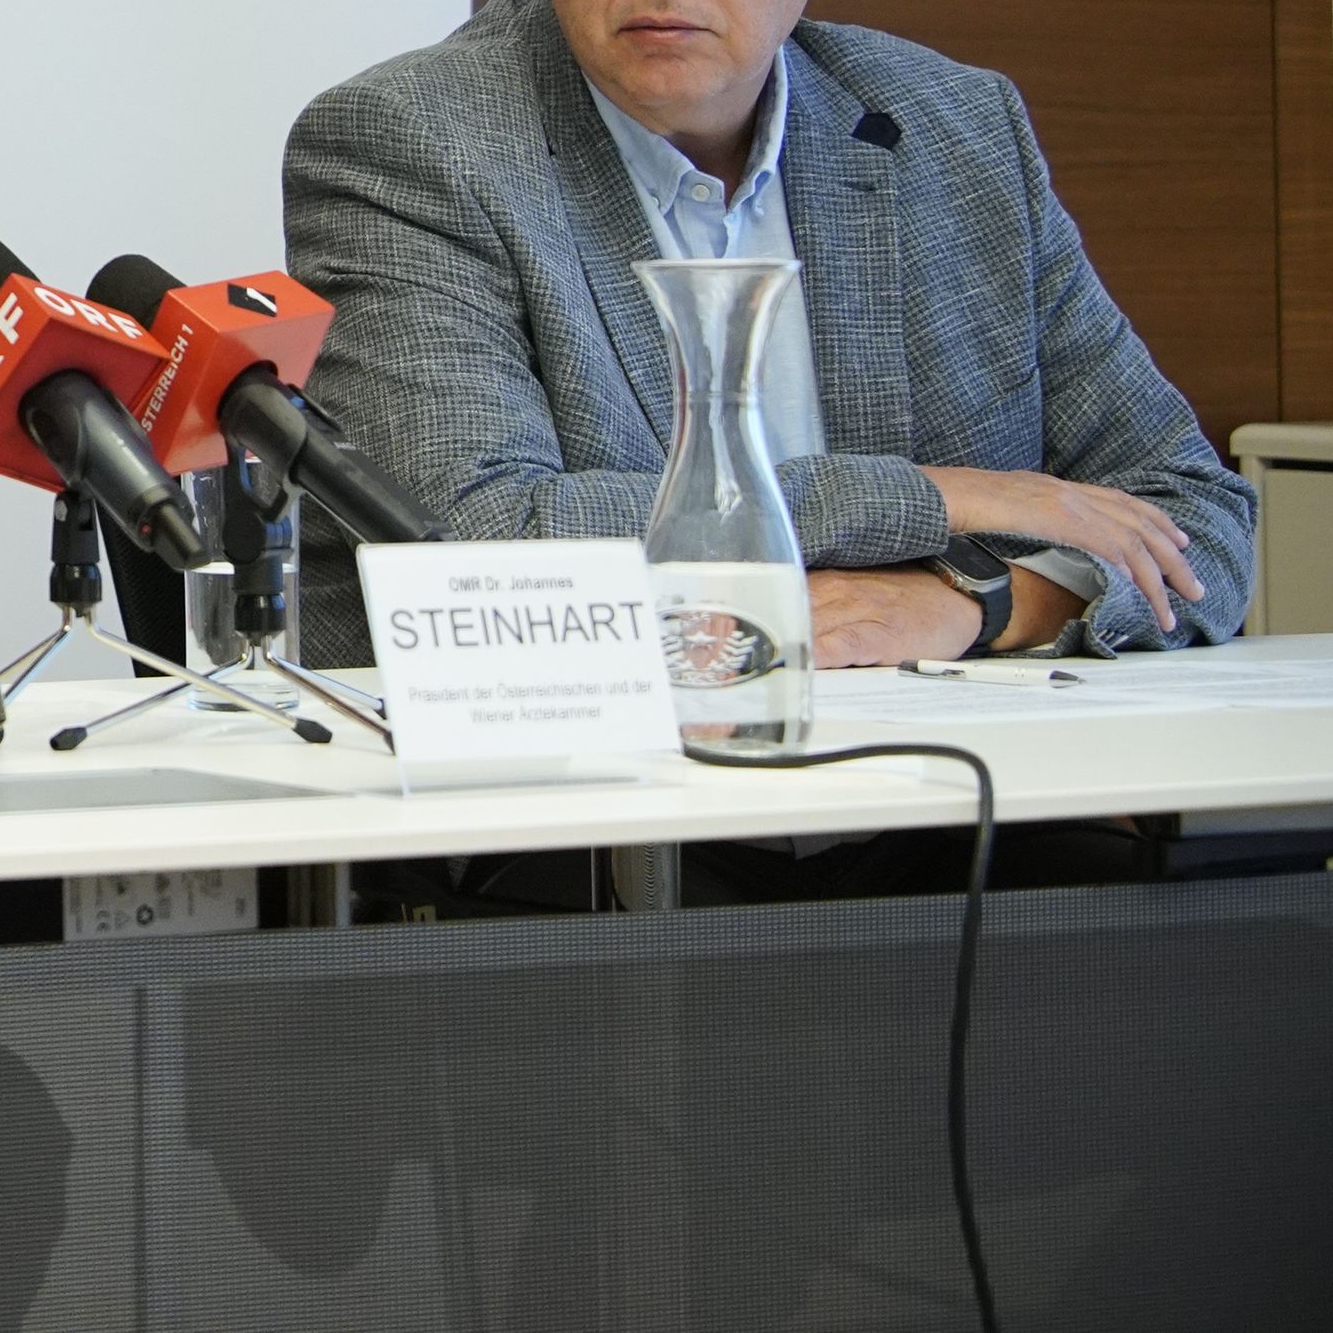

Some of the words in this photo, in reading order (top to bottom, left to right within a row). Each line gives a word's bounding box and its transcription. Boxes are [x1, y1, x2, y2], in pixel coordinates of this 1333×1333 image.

[34, 286, 144, 340] ORF
[141, 334, 190, 435] STERREICH
[509, 574, 575, 592] Johannes
[389, 600, 644, 650] STEINHART
